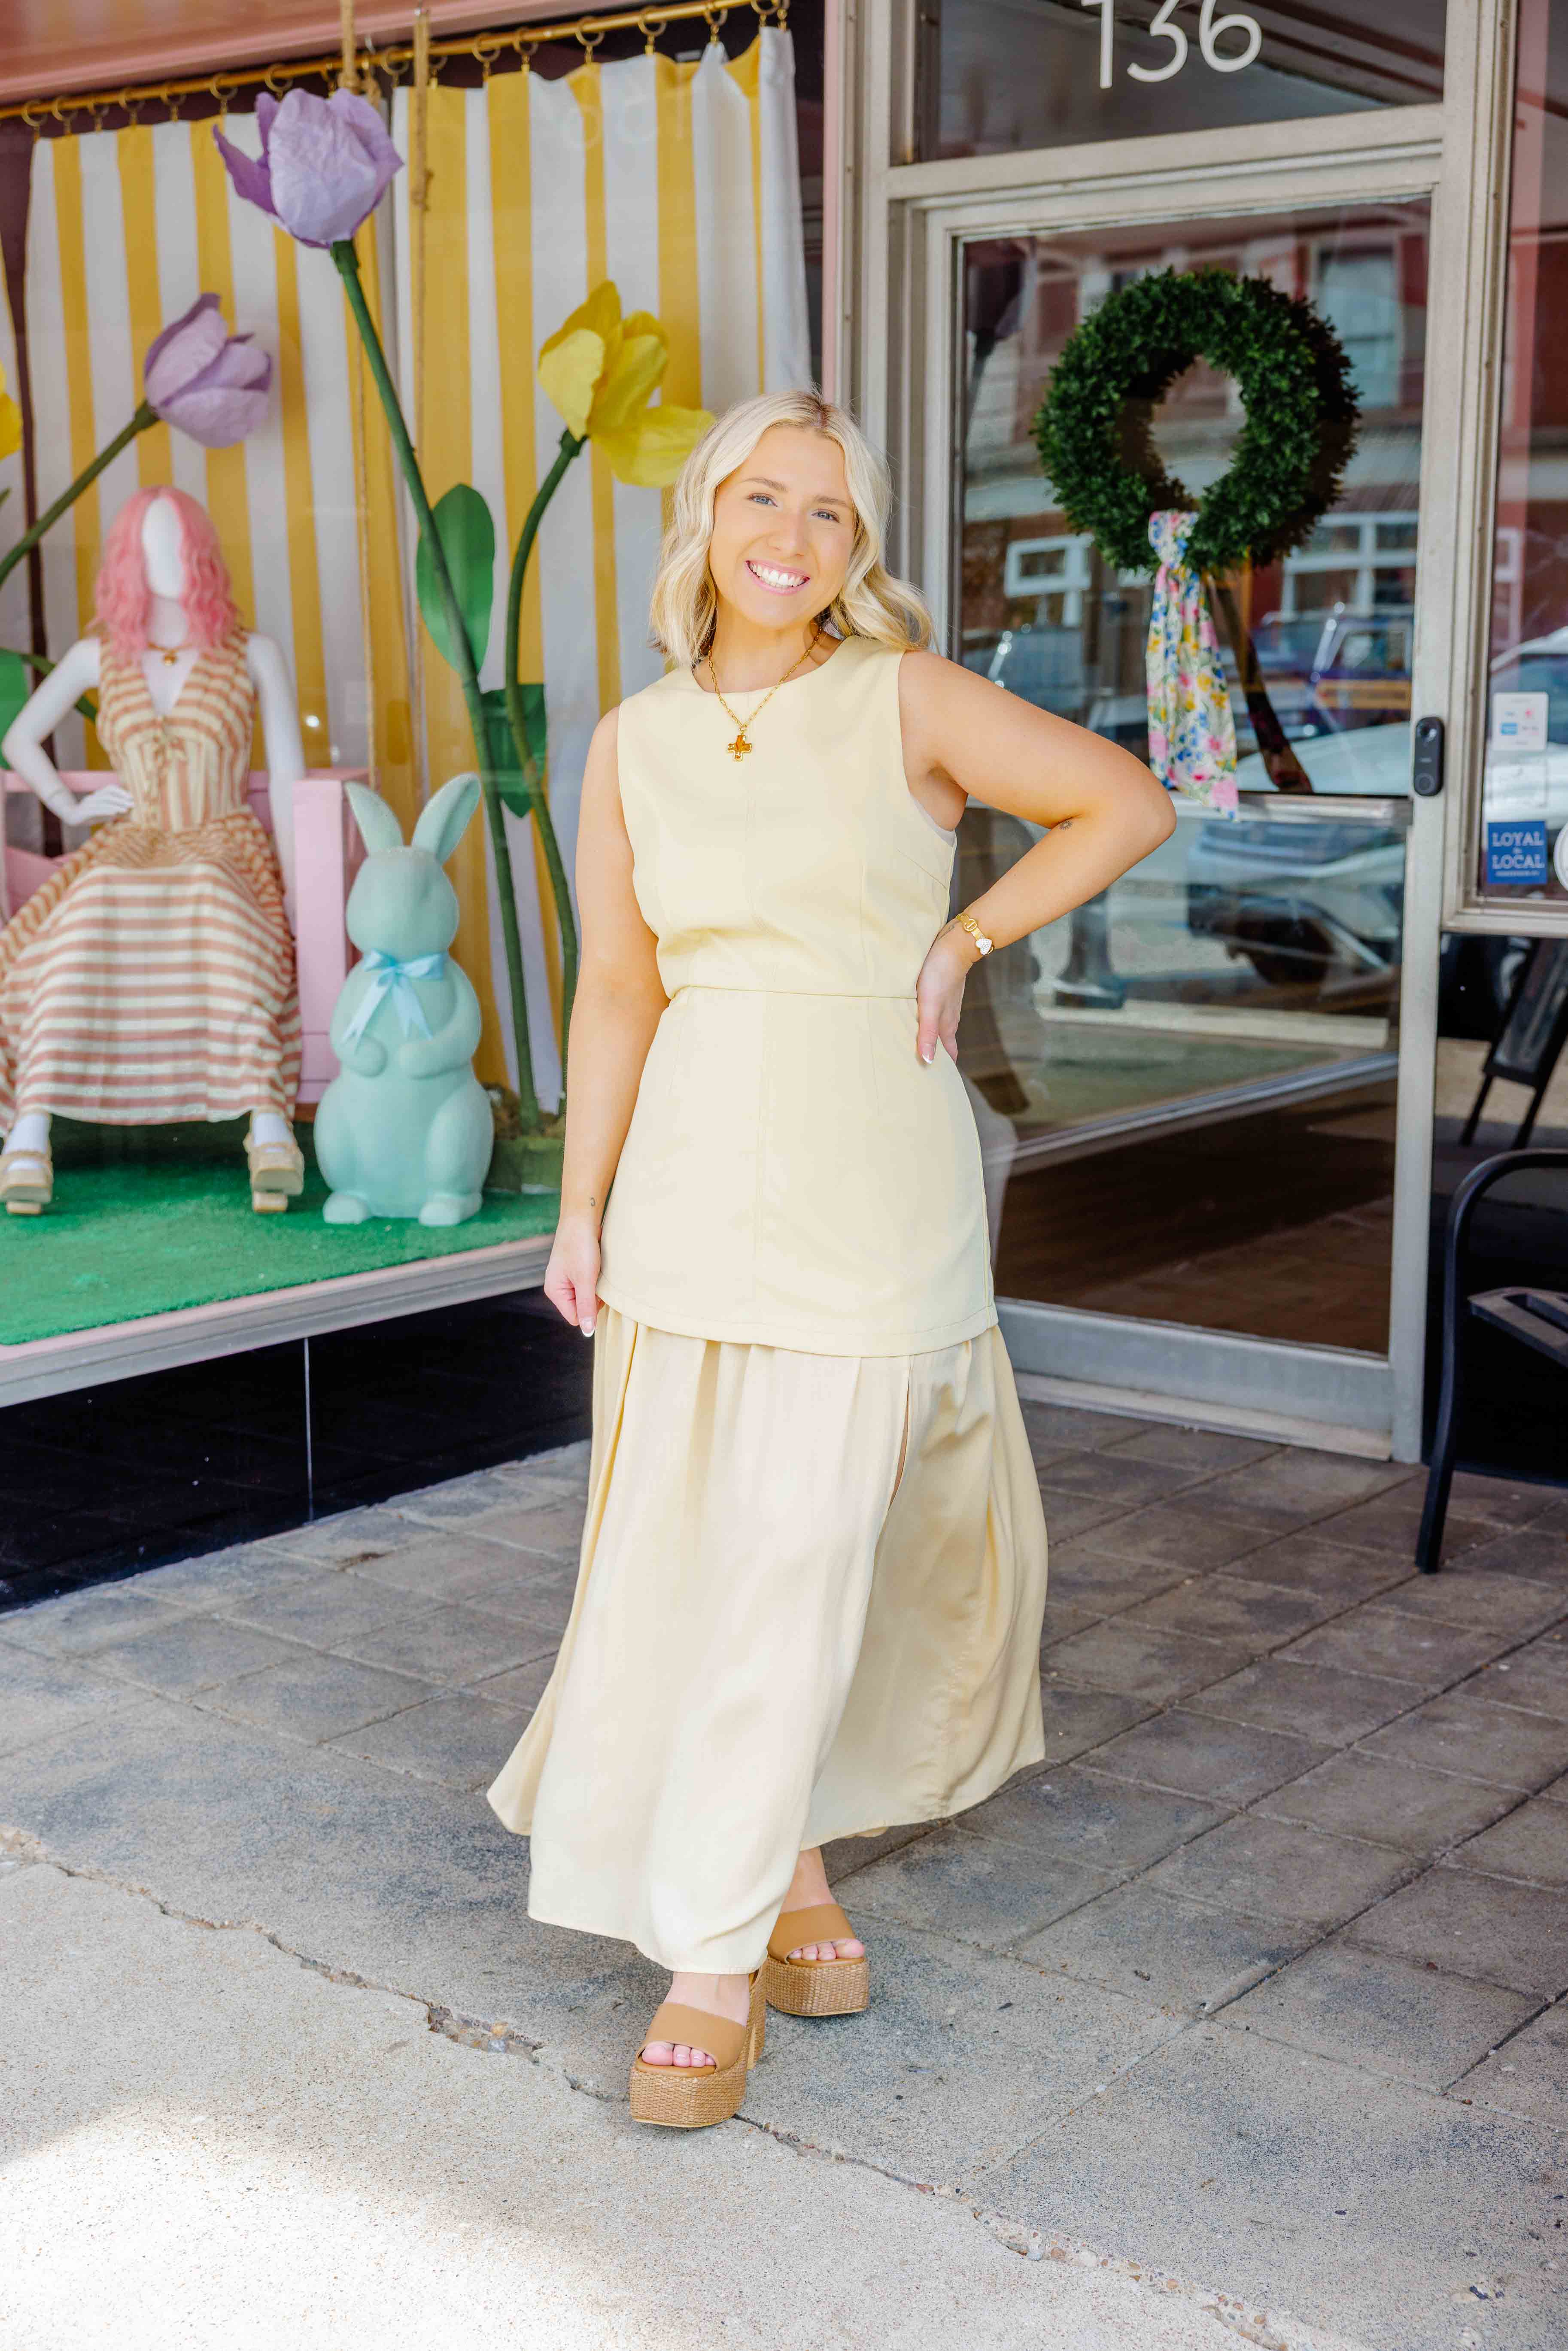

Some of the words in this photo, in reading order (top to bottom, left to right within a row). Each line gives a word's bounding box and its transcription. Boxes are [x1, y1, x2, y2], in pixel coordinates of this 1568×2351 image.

[1081, 0, 1262, 88] 136
[1492, 832, 1544, 847] LOYAL
[1492, 854, 1545, 869] LOCAL
